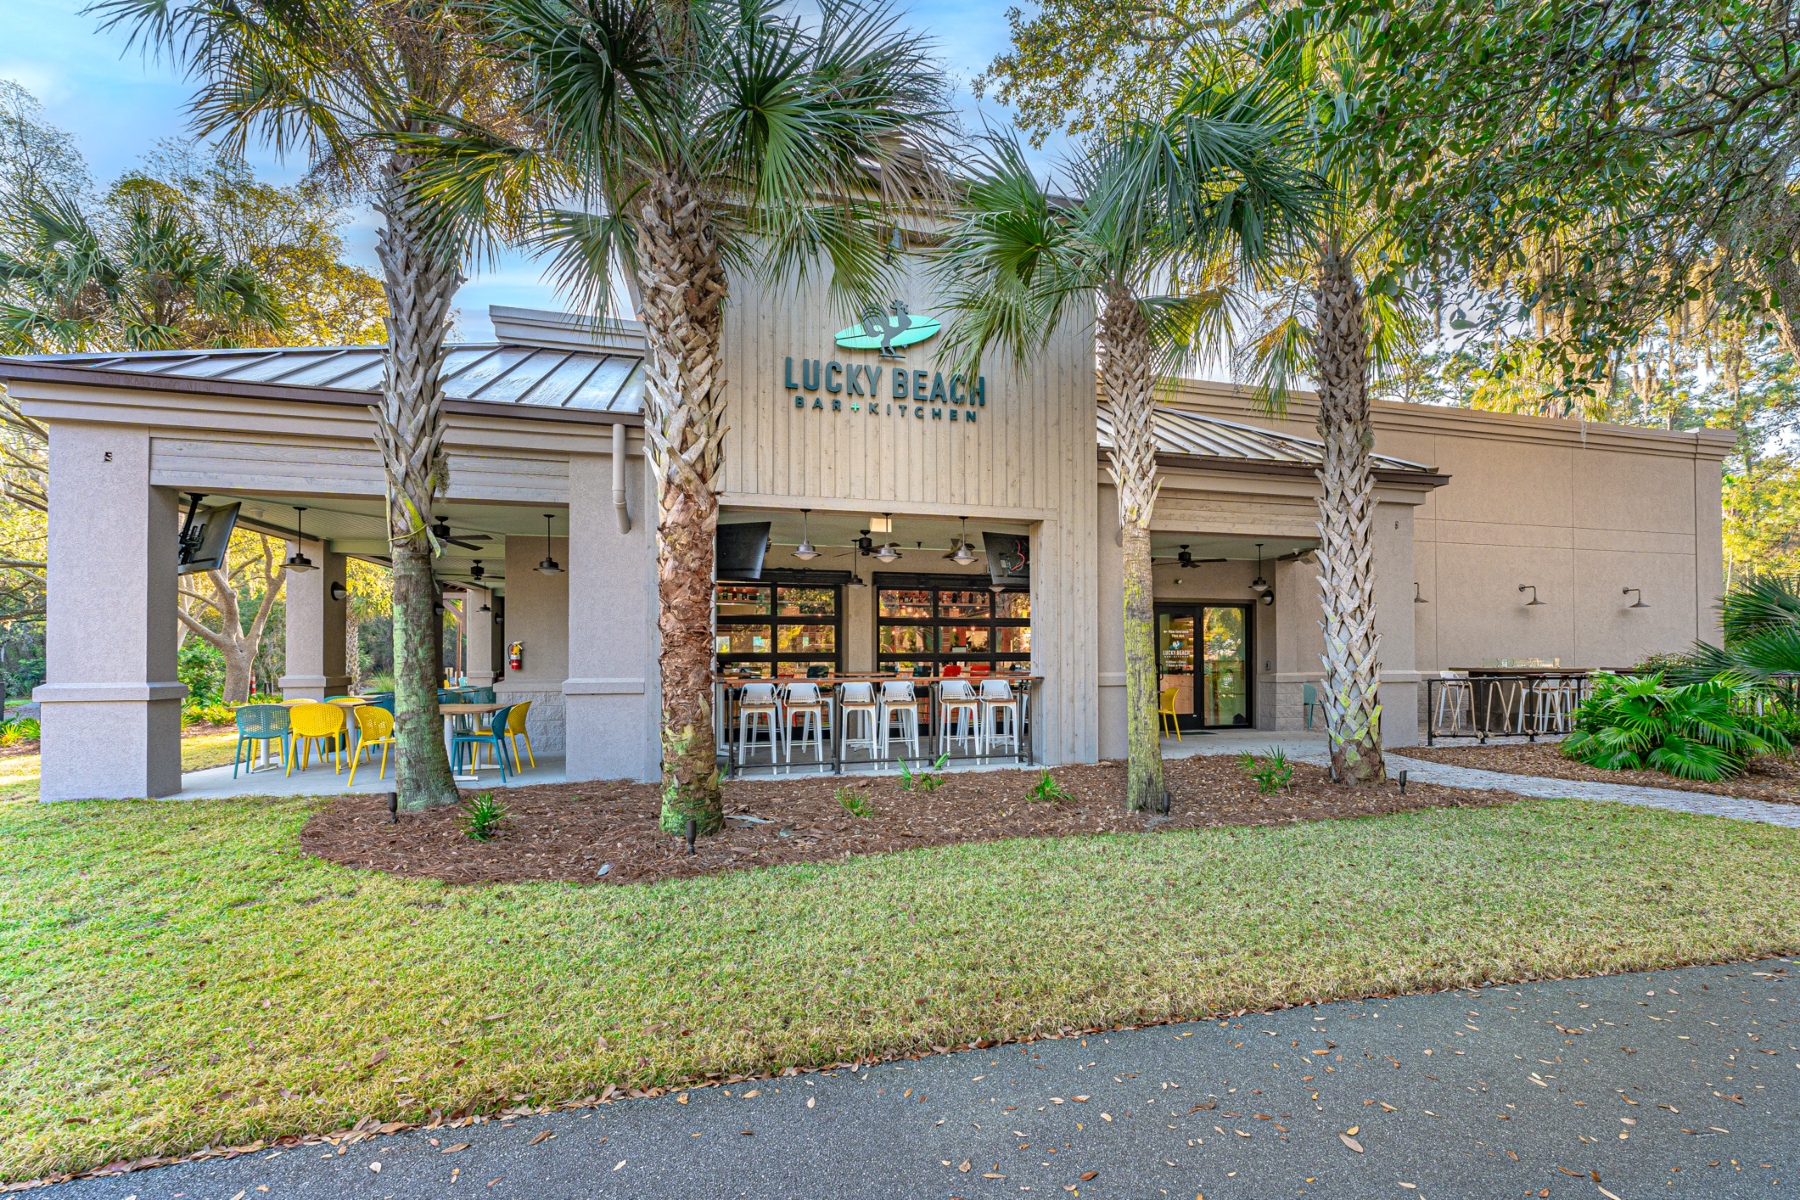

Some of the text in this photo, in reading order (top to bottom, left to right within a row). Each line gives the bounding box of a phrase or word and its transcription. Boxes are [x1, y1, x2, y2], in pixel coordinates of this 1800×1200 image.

[785, 357, 986, 407] LUCKY BEACH
[795, 395, 841, 412] BAR
[868, 402, 977, 422] KITCHEN
